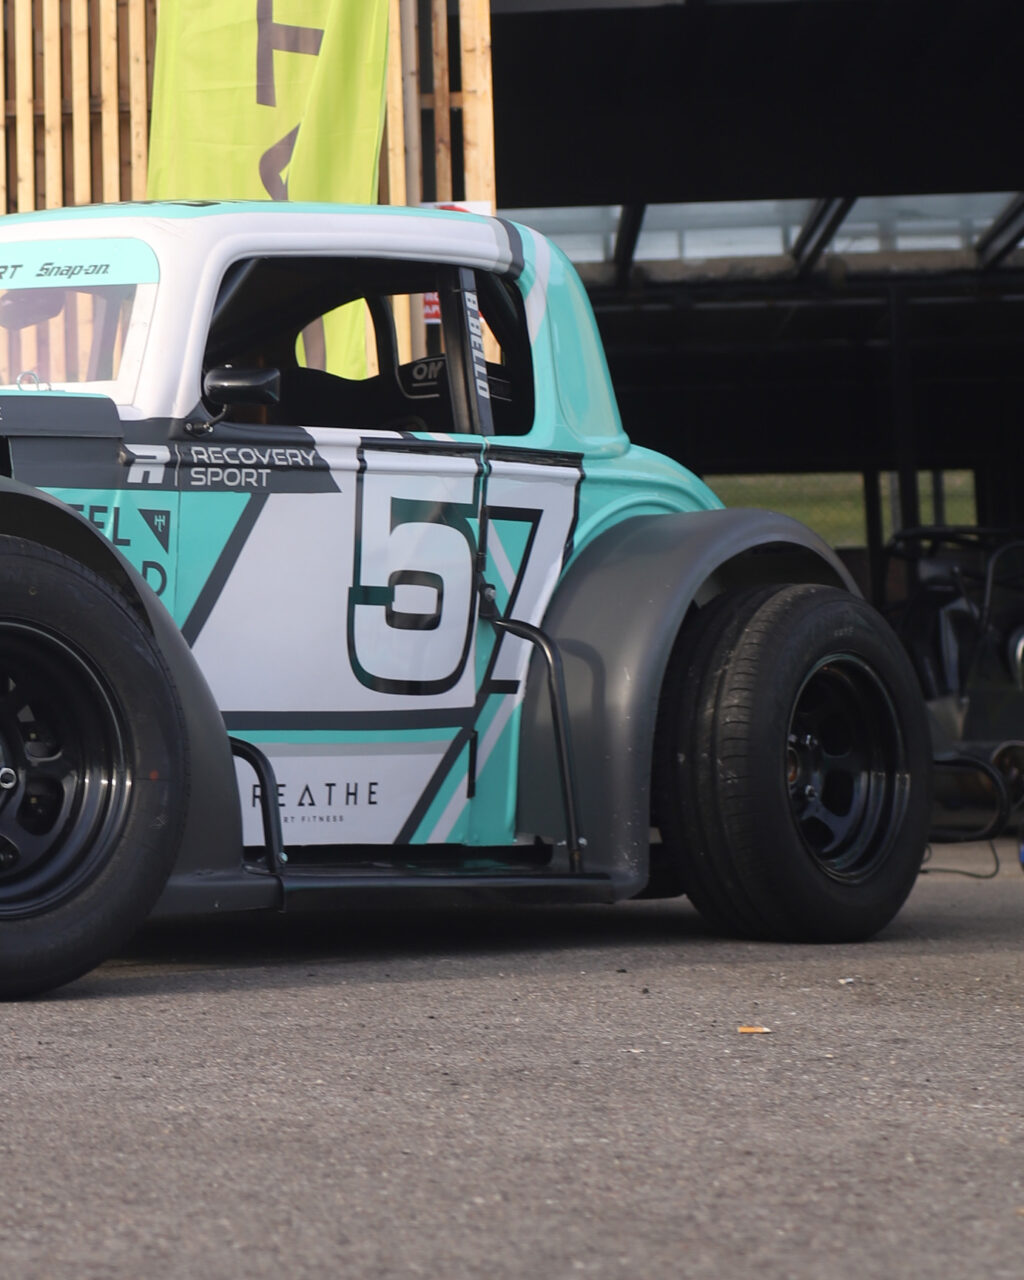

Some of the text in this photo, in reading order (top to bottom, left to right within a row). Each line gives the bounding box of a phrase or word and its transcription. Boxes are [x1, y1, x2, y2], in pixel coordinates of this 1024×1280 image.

[36, 261, 110, 279] Snap-on
[190, 446, 316, 467] RECOVERY
[190, 468, 271, 487] SPORT
[346, 437, 584, 700] 57
[301, 815, 344, 823] FITNESS
